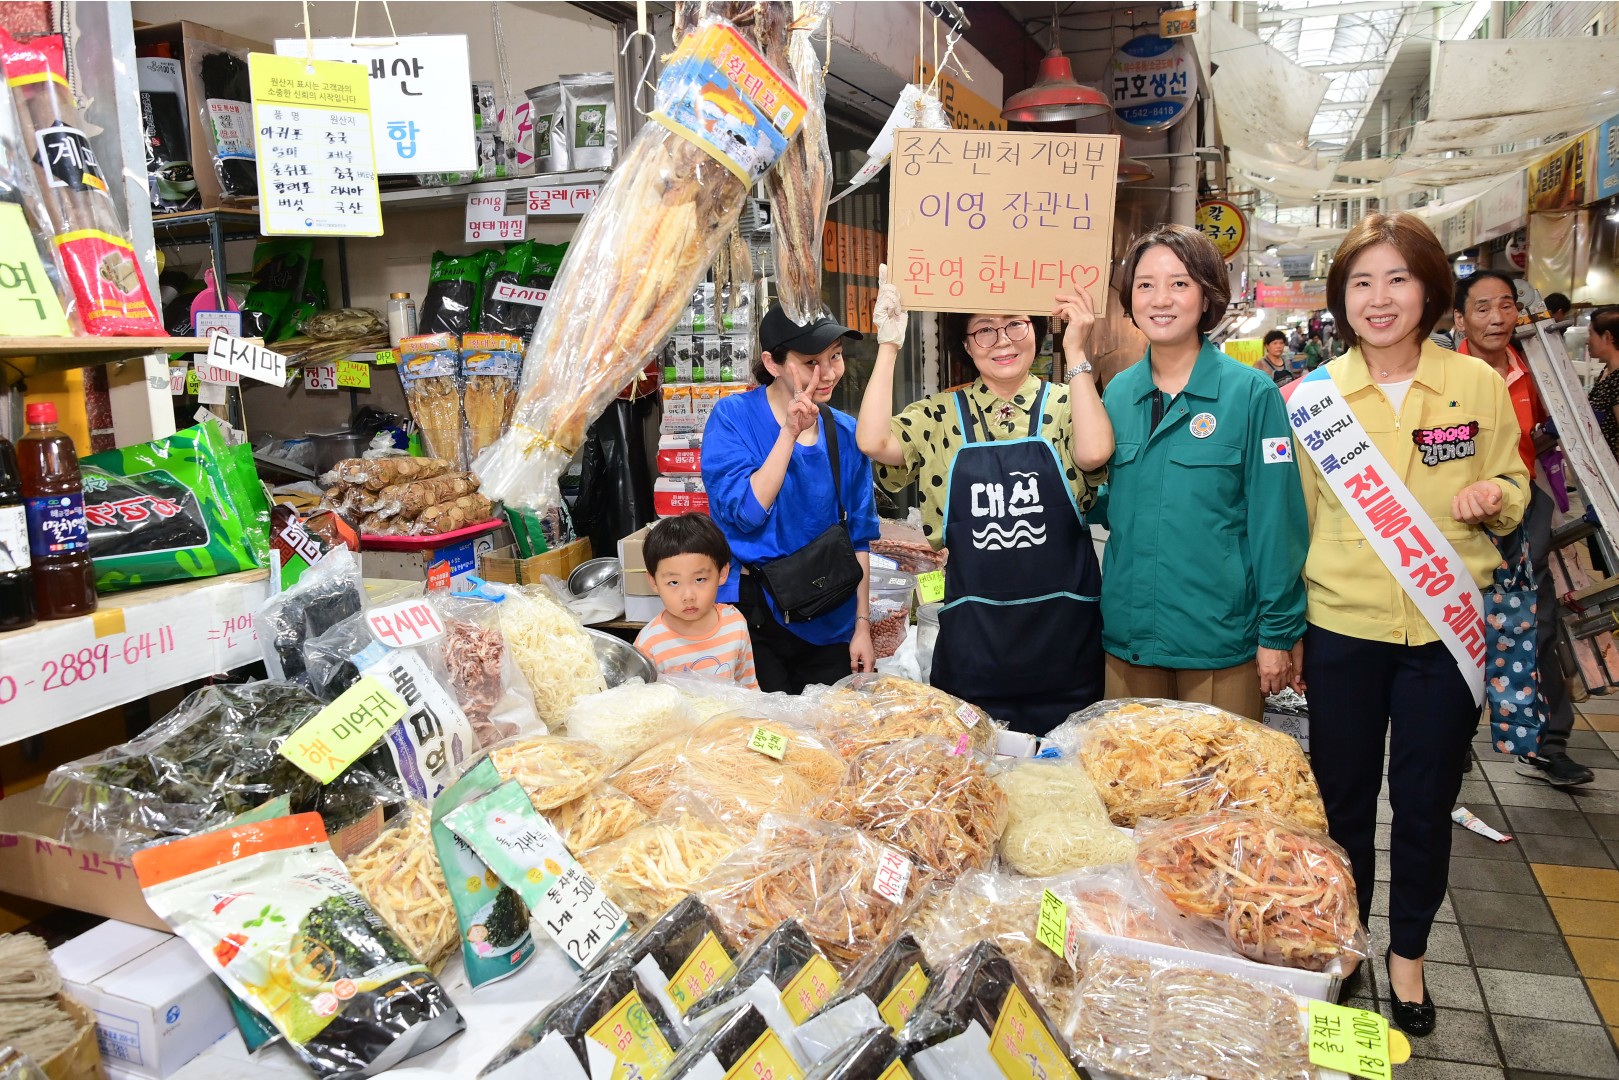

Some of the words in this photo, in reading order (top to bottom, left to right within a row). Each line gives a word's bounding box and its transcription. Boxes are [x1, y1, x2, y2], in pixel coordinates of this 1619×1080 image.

[270, 77, 294, 88] 원산지
[296, 80, 320, 91] 표시는
[322, 83, 352, 94] 고객과의
[334, 57, 424, 97] 내산
[726, 55, 779, 115] 황태포
[1114, 71, 1187, 101] 규호생선
[268, 87, 291, 98] 소중한
[319, 93, 357, 104] 시작입니다
[330, 114, 356, 126] 원산지
[1124, 105, 1174, 119] T.542-8418
[260, 126, 303, 141] 아귀포
[325, 131, 349, 145] 중국
[386, 120, 420, 159] 합
[901, 136, 953, 176] 중소
[1030, 139, 1105, 181] 기업부
[333, 166, 354, 181] 중국
[330, 185, 364, 196] 러시아
[470, 197, 502, 212] 다시용
[278, 198, 304, 212] 버섯
[335, 202, 364, 215] 국산
[919, 191, 987, 230] 이영
[1002, 190, 1093, 231] 장관님
[1209, 206, 1224, 221] 칼
[469, 220, 523, 239] 명태껍질
[903, 248, 965, 297] 환영
[978, 254, 1069, 294] 합니다
[213, 335, 282, 377] 다시마
[305, 366, 336, 388] 청각
[1290, 396, 1334, 429] 해운대
[1304, 414, 1354, 451] 장바구니
[1320, 439, 1371, 475] 쿡cook
[970, 471, 1044, 518] 대선
[1344, 464, 1455, 597] 전통시장
[370, 604, 442, 645] 다시마
[299, 738, 345, 771] 햇
[332, 691, 397, 740] 미역귀
[547, 887, 564, 905] 돌
[547, 911, 574, 937] 1개
[1040, 889, 1063, 948] 쥐포채
